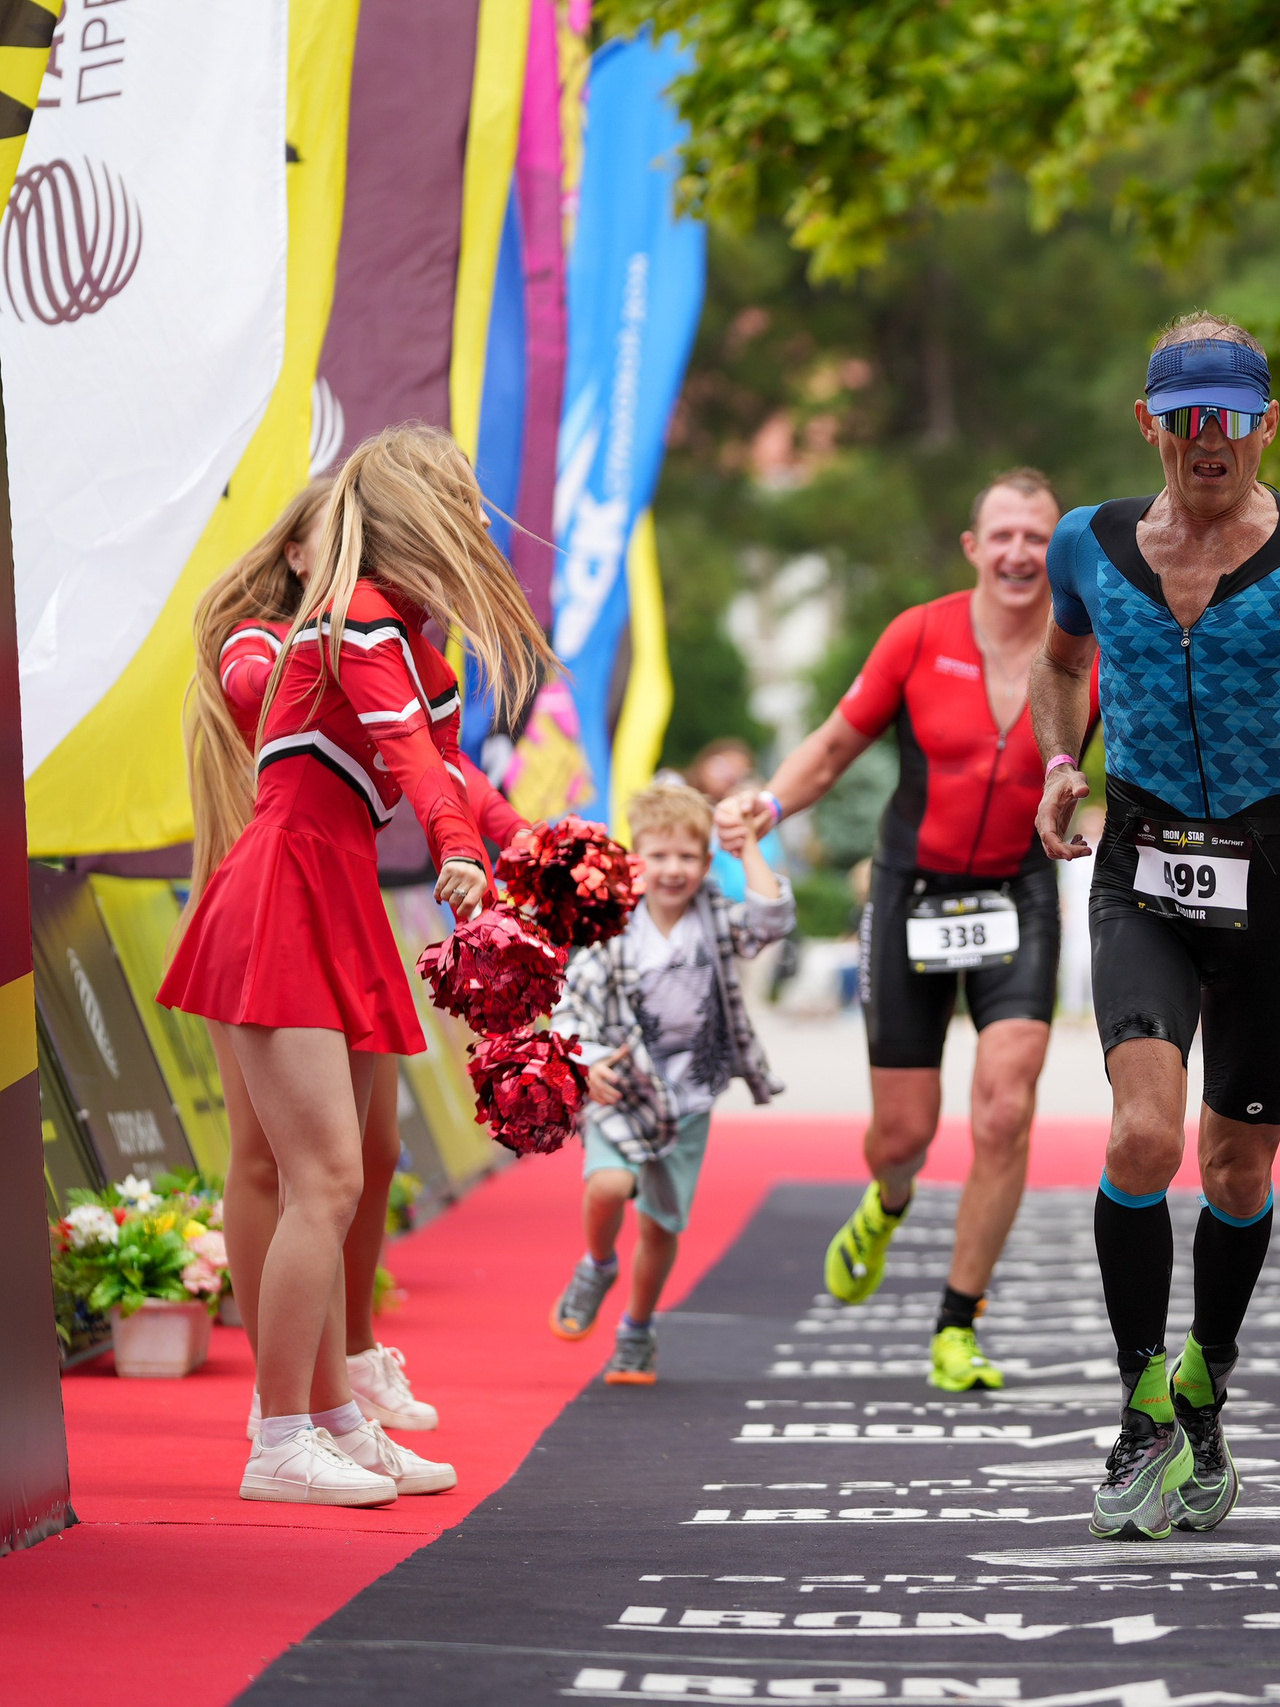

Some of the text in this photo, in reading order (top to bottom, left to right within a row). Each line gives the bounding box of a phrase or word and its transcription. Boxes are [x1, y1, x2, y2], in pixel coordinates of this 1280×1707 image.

[1162, 829, 1180, 840] IRON
[1187, 830, 1205, 841] STAR
[1218, 838, 1245, 847] МАГНИТ
[1163, 861, 1217, 899] 499
[940, 923, 986, 949] 338
[740, 1424, 1032, 1437] IRON
[692, 1507, 1032, 1521] IRON
[617, 1605, 1024, 1628] IRON
[572, 1667, 1020, 1699] IRON
